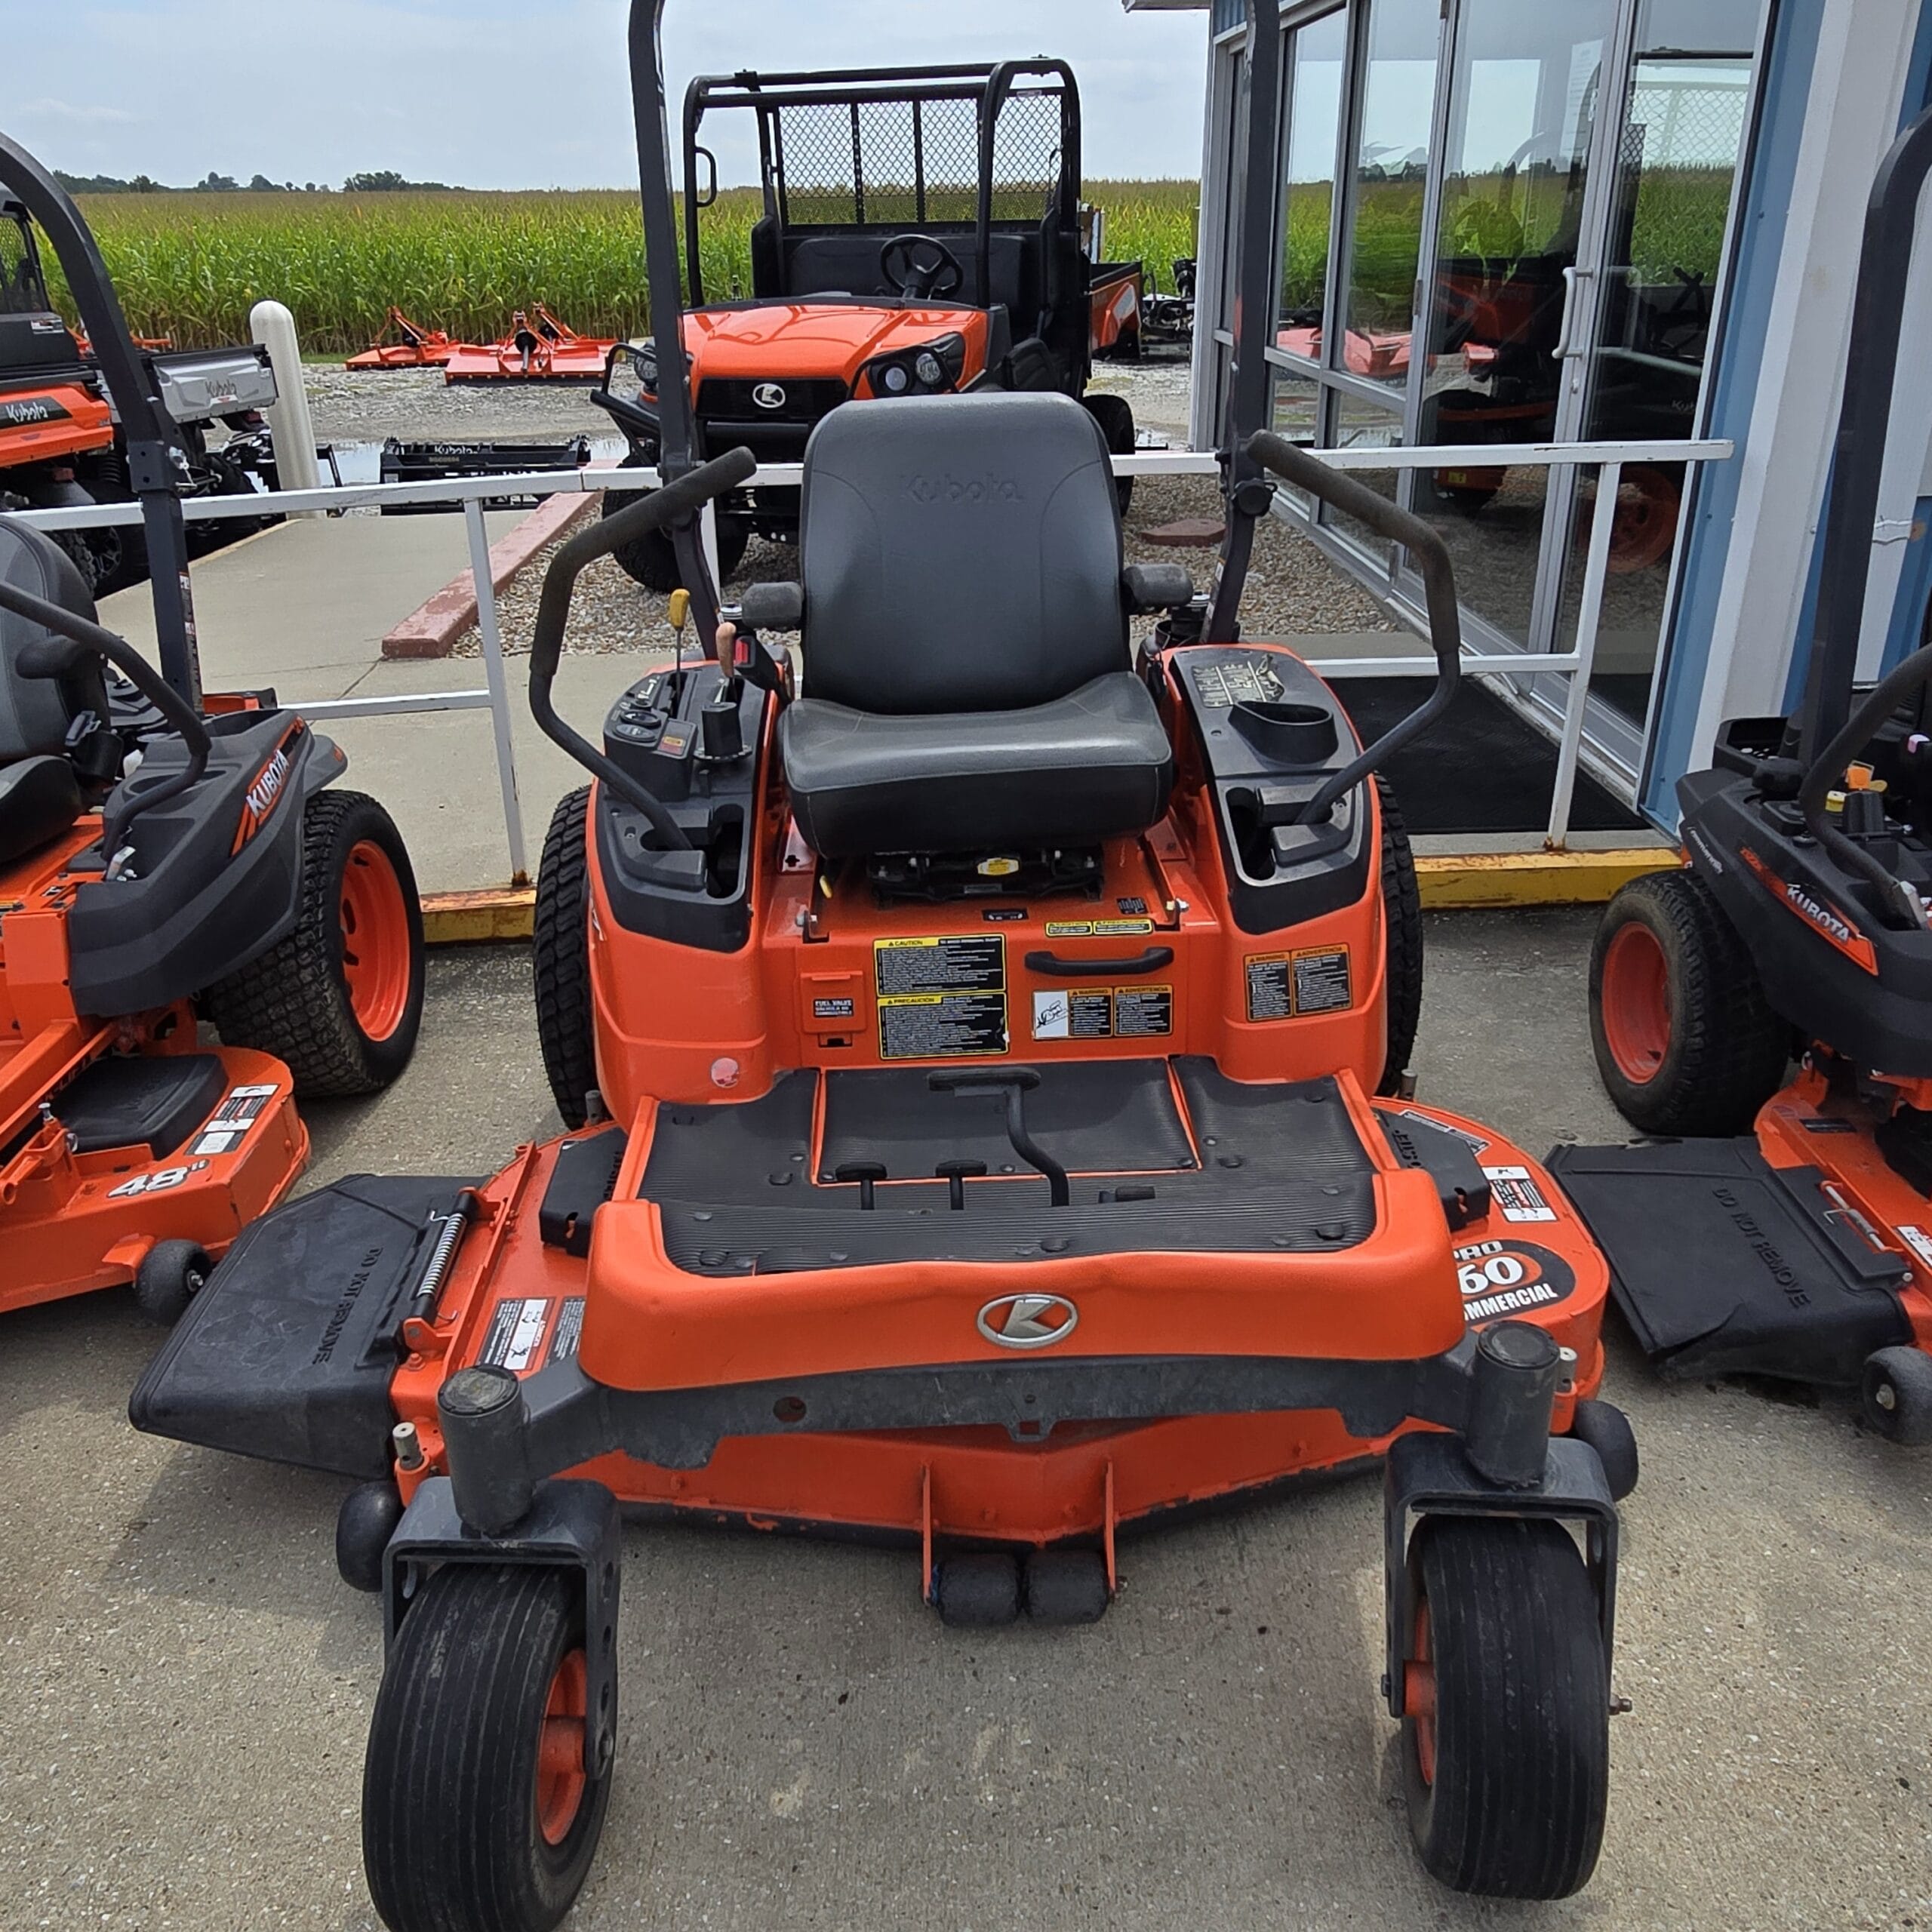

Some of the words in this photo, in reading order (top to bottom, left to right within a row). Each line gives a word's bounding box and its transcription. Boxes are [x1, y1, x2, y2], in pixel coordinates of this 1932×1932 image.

[5, 401, 48, 423] Kubota
[245, 749, 290, 819] KUBOTA
[1787, 884, 1850, 942] KUBOTA
[360, 1247, 384, 1268] DO
[1712, 1188, 1738, 1208] DO
[1730, 1211, 1766, 1238] NOT
[1751, 1241, 1812, 1309] REMOVE
[343, 1271, 371, 1298] NOT
[1457, 1257, 1523, 1294] 60
[1464, 1282, 1558, 1321] MMERCIAL
[312, 1299, 355, 1365] REMOVE
